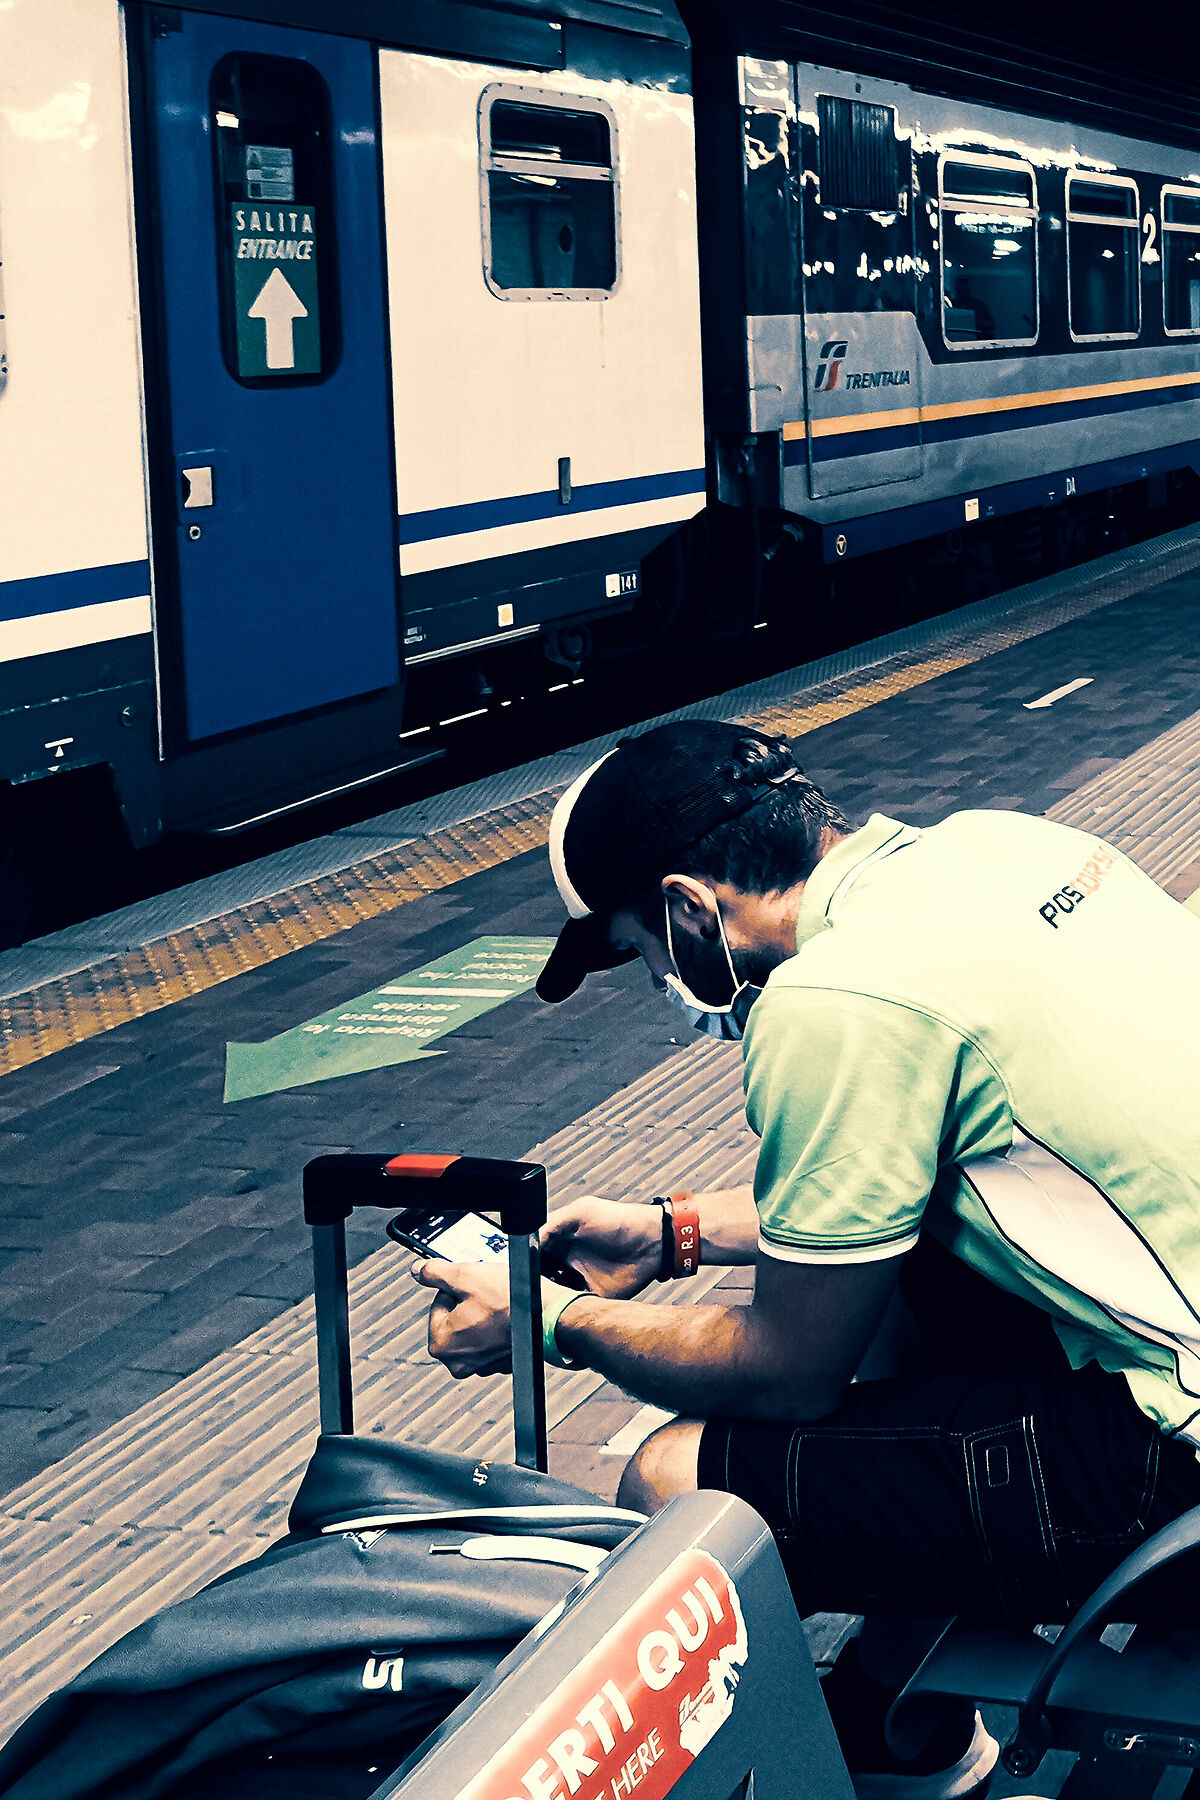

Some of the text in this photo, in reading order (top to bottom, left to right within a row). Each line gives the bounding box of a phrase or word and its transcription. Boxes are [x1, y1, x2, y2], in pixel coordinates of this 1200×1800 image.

[235, 210, 313, 233] SALITA
[1141, 212, 1161, 262] 2
[237, 239, 314, 260] ENTRANCE
[845, 370, 911, 390] TRENITALIA
[502, 1576, 725, 1800] ERTI QUI
[610, 1726, 665, 1800] HERE
